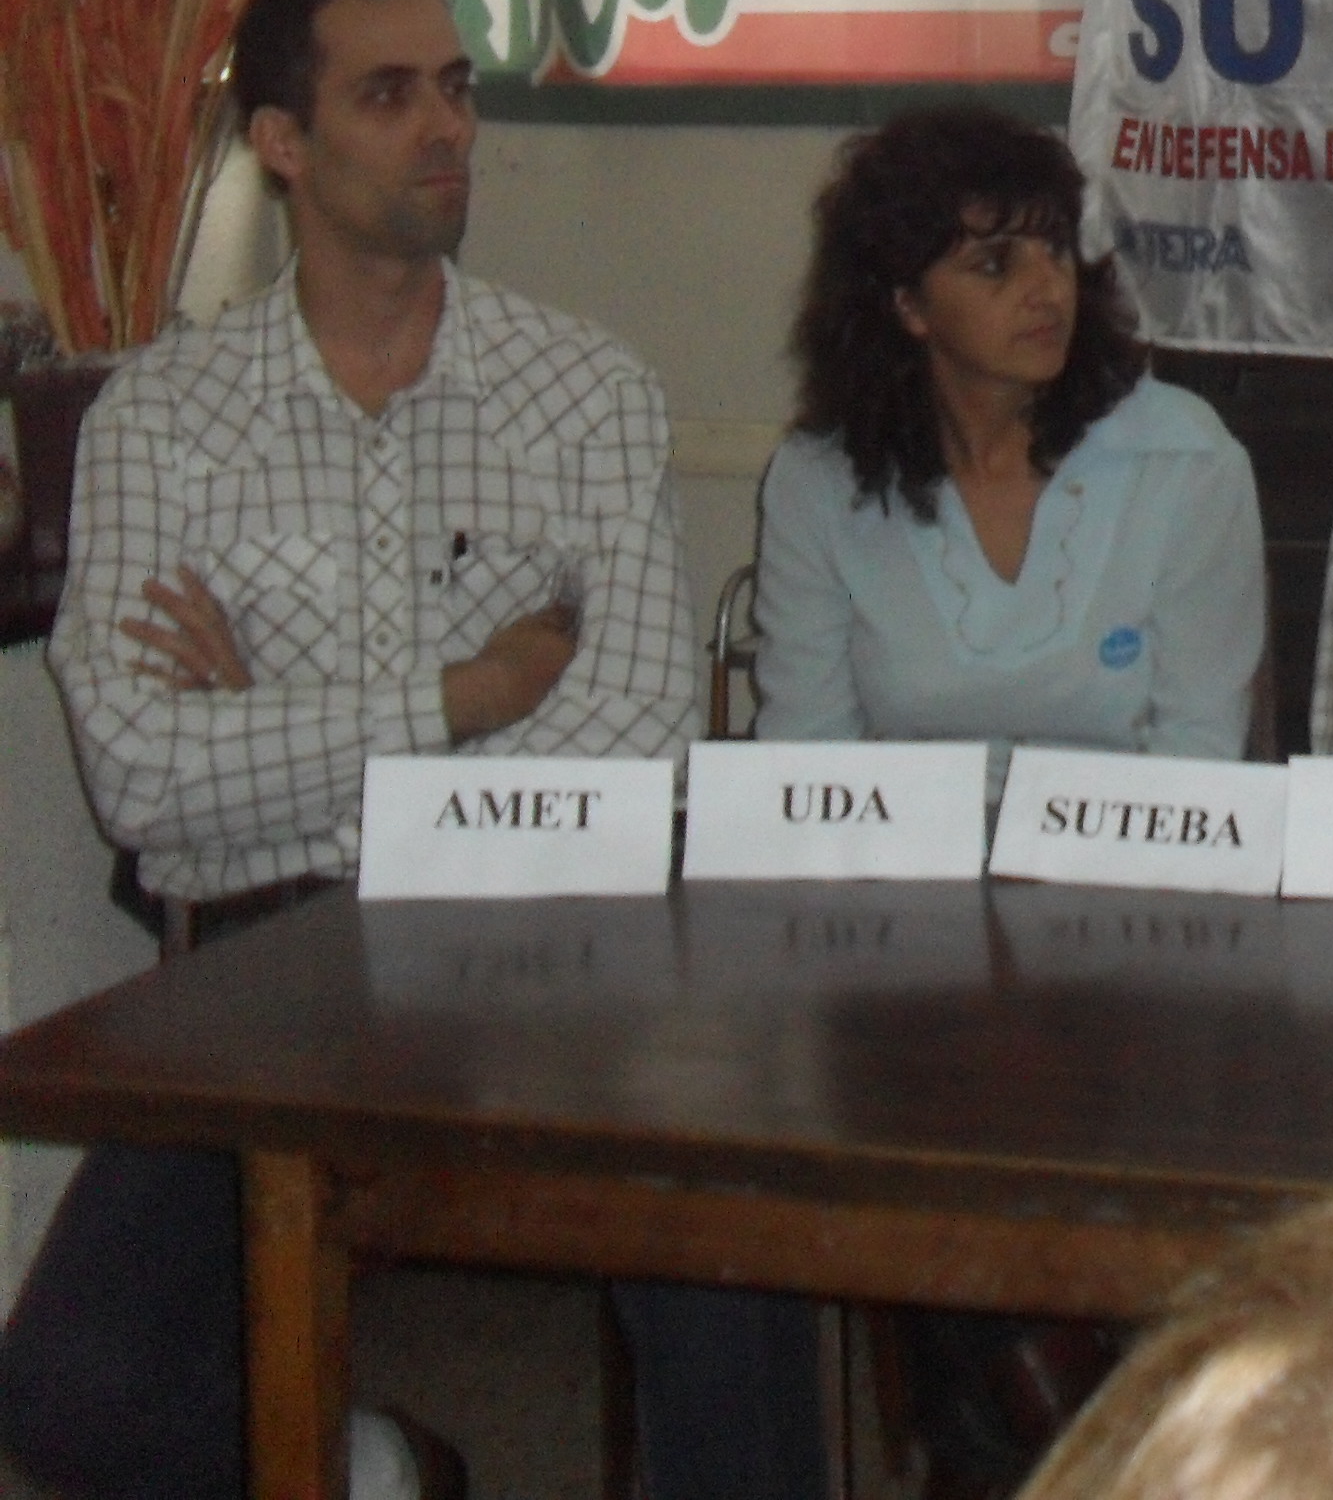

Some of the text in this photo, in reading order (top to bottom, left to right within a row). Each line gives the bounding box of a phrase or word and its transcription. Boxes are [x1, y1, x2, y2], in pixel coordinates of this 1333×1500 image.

[1111, 117, 1157, 173] EN
[1160, 123, 1314, 181] DEFENSA
[433, 788, 602, 832] AMET
[780, 783, 893, 825] UDA
[1040, 796, 1245, 849] SUTEBA
